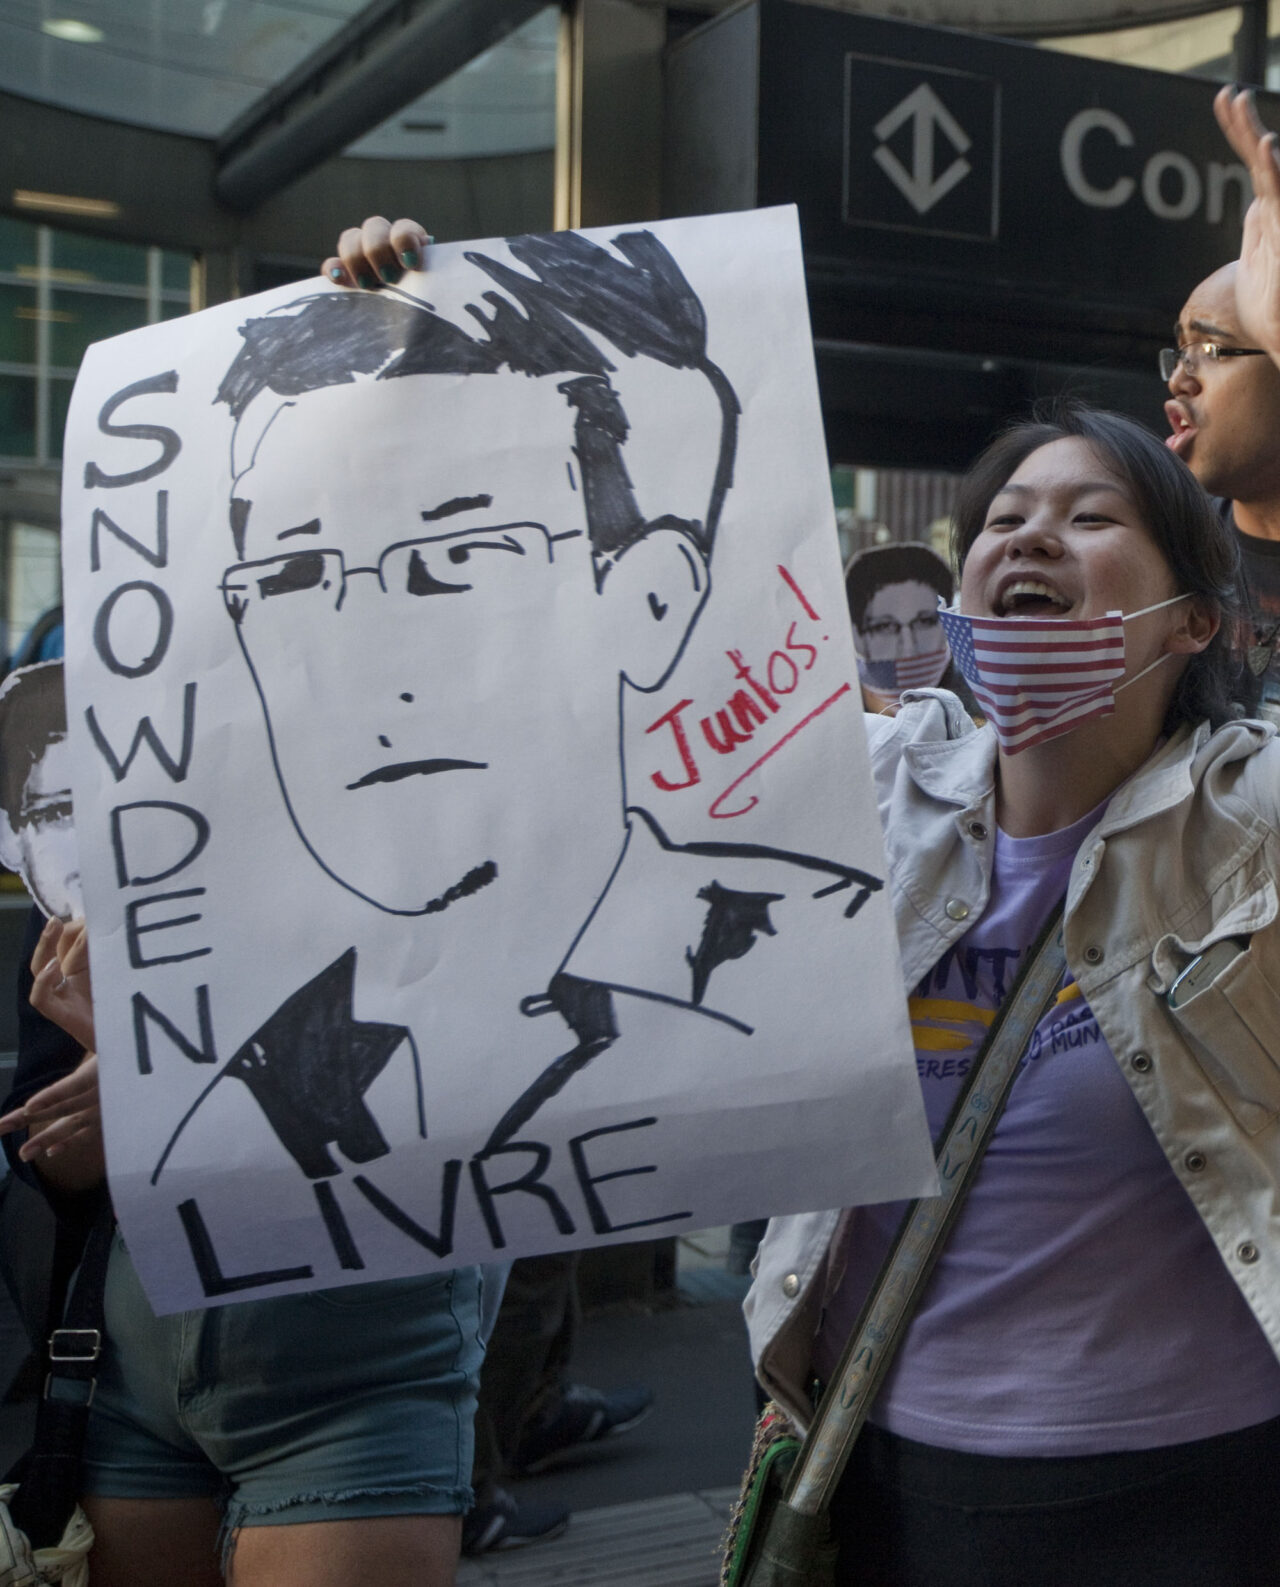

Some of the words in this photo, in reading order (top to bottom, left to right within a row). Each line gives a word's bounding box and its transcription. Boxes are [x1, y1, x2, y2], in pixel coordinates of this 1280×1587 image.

[83, 370, 219, 1077] SNOWDEN
[644, 564, 830, 792] Juntos!
[177, 1116, 694, 1299] LIVRE
